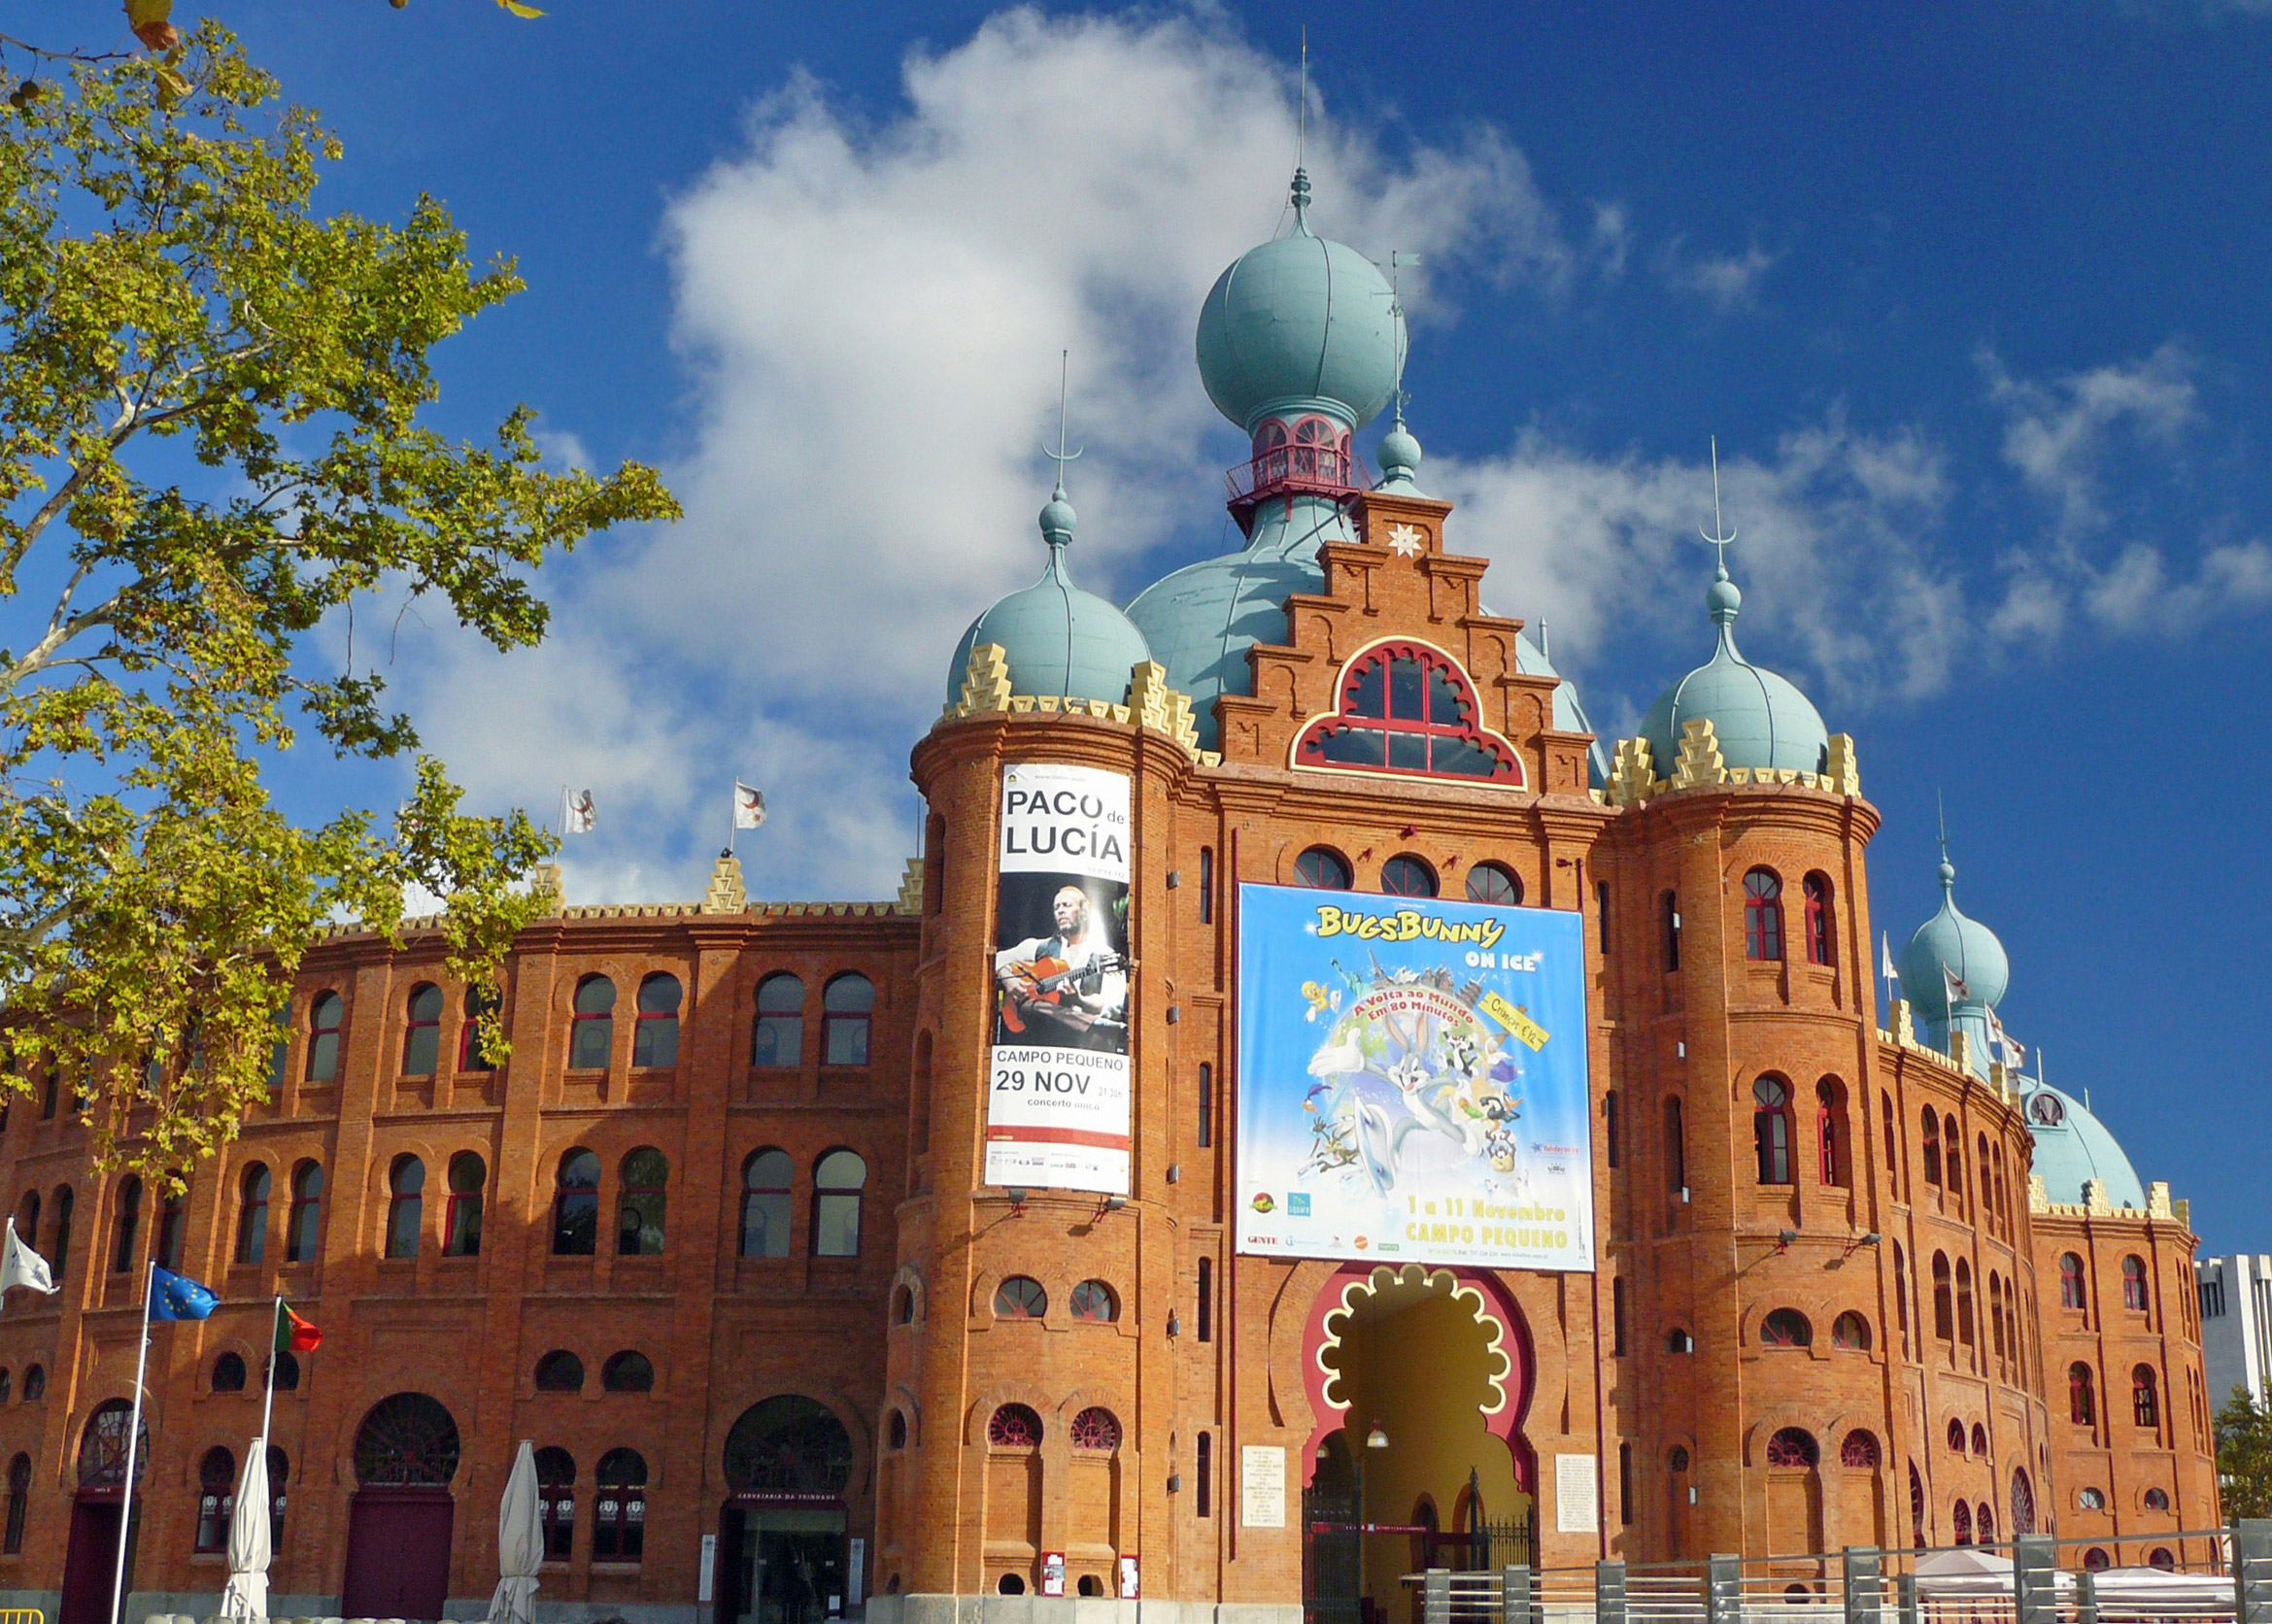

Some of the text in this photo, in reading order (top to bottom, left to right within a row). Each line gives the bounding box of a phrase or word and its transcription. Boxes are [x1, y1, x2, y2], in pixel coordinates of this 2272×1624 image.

[1007, 790, 1125, 825] PACO de
[1006, 824, 1124, 863] LUCÍA
[1465, 951, 1537, 971] ON ICE
[1353, 990, 1475, 1024] A Volta ao Mundo
[1368, 1000, 1461, 1028] Em 80 Minutos
[1491, 998, 1521, 1031] Crianças
[997, 1050, 1124, 1071] CAMPO PEQUENO
[996, 1069, 1026, 1092] 29
[1034, 1070, 1091, 1095] NOV
[1027, 1099, 1071, 1108] concerto
[1407, 1195, 1566, 1223] 1 a 11 Novembro
[1247, 1235, 1278, 1245] GENTE
[1406, 1223, 1475, 1244] CAMPO
[1481, 1226, 1568, 1249] PEQUENO
